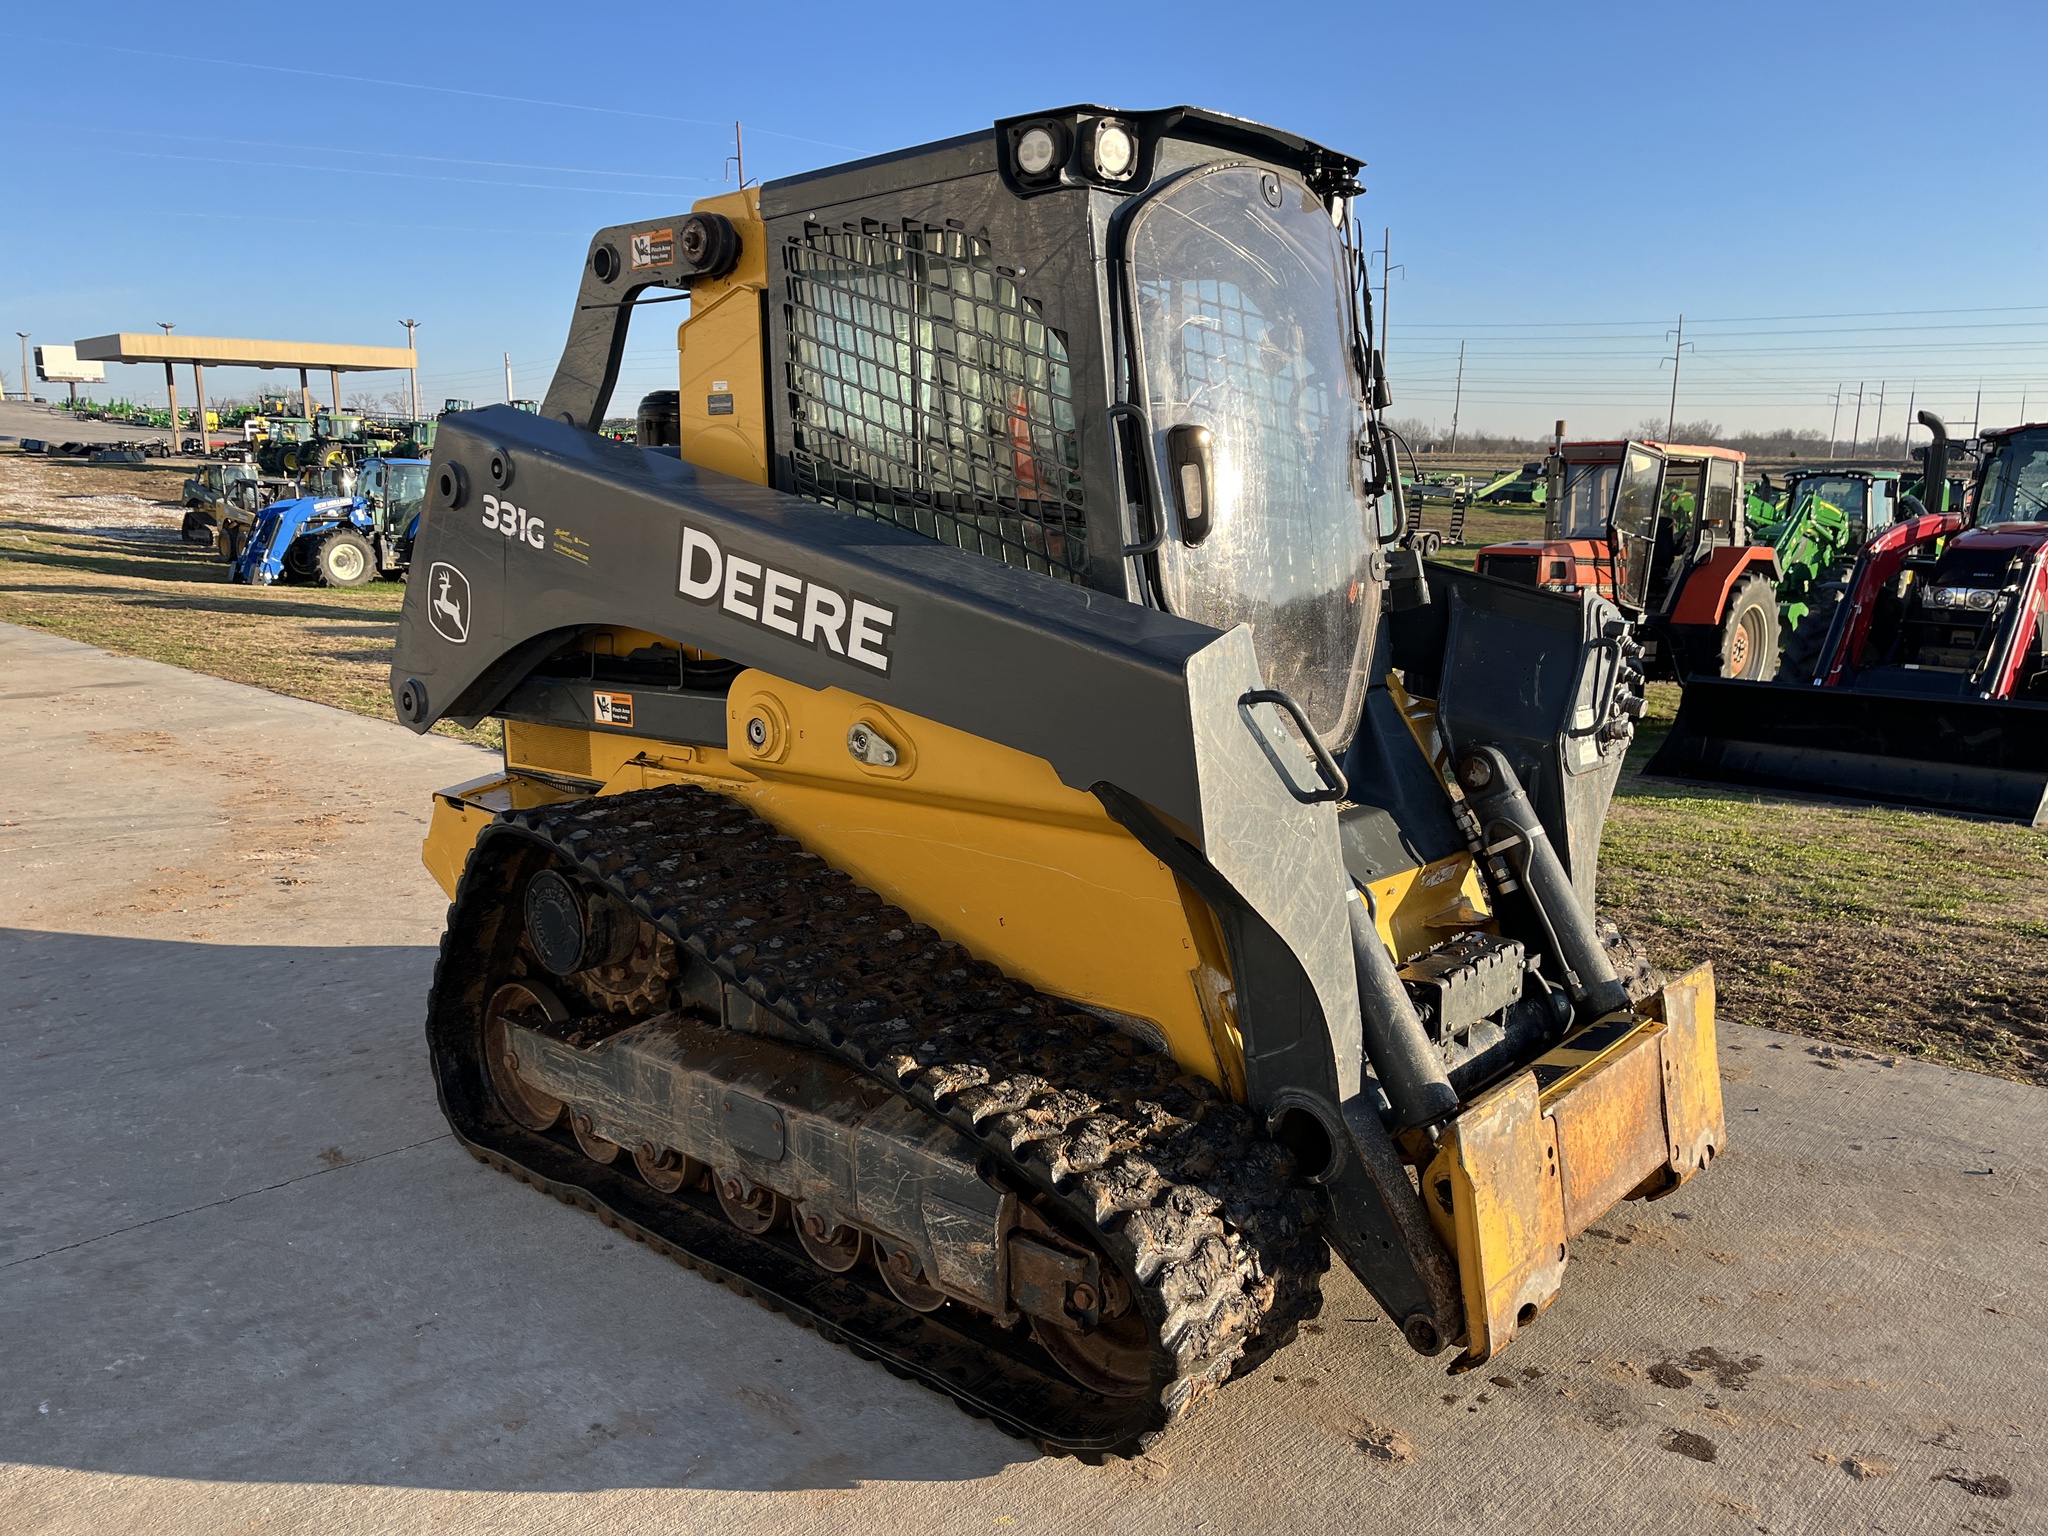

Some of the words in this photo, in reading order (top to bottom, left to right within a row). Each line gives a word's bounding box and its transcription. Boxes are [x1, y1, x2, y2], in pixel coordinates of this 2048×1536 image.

[313, 501, 327, 510] NEW
[482, 494, 545, 550] 331G
[679, 526, 893, 671] DEERE
